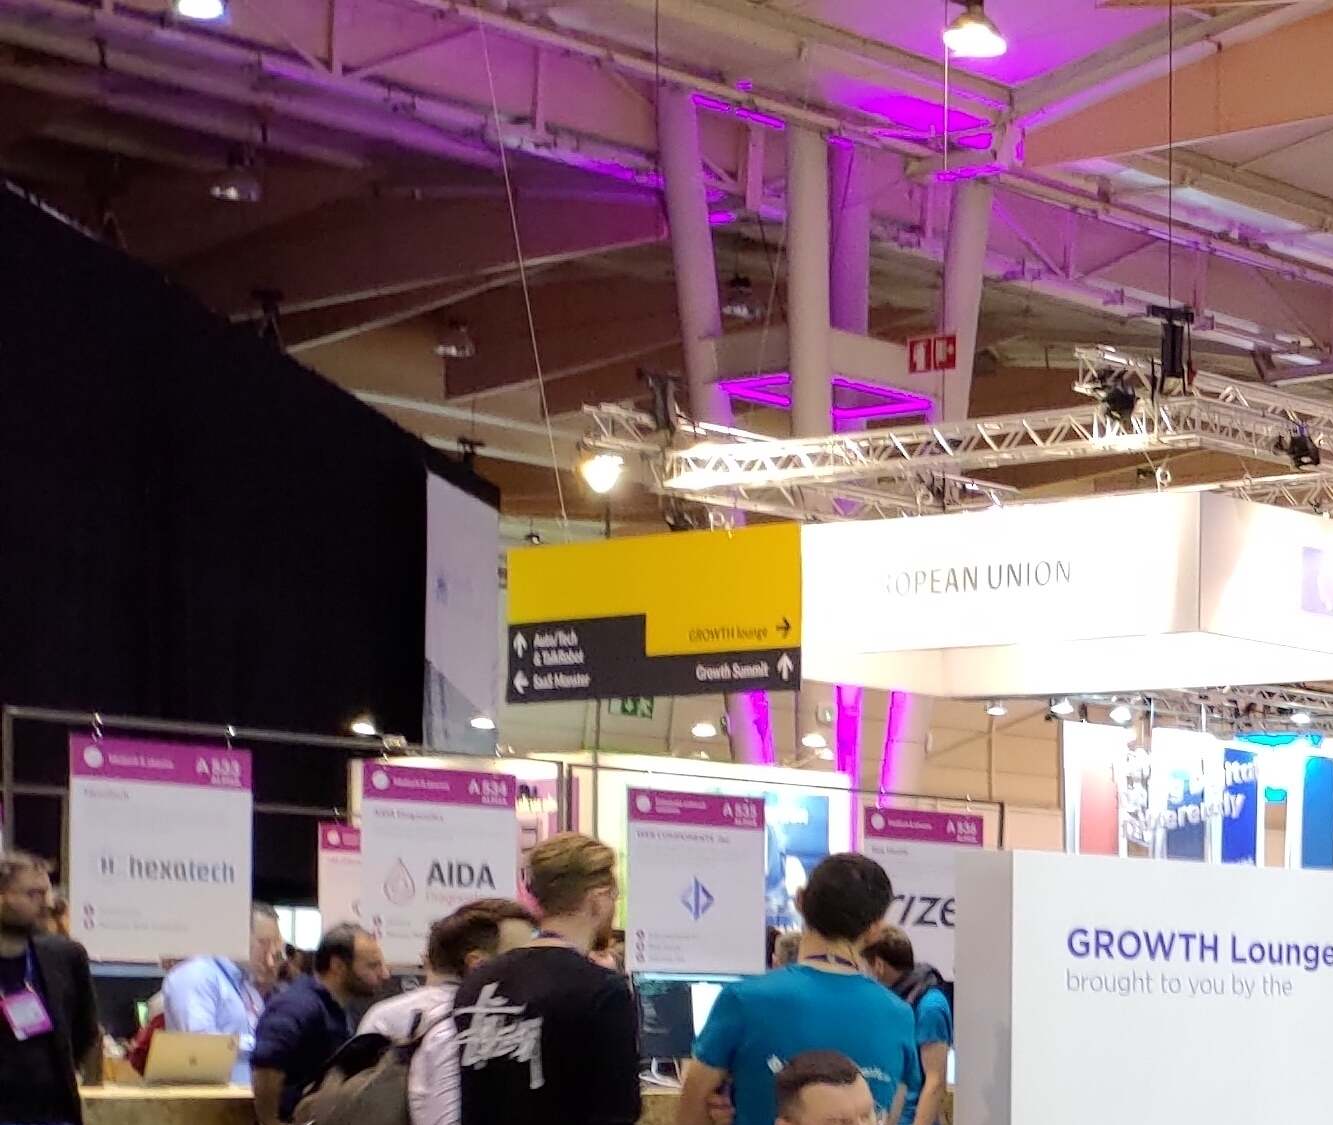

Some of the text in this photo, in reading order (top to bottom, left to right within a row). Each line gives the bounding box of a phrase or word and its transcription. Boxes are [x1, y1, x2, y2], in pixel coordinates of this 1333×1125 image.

[987, 560, 1071, 591] UNION
[689, 627, 734, 642] GROWTH
[696, 660, 769, 682] Growth Summit
[129, 854, 235, 884] hexatech
[426, 858, 496, 890] AIDA
[1067, 928, 1218, 963] GROWTH
[1066, 968, 1293, 999] brought to you by the
